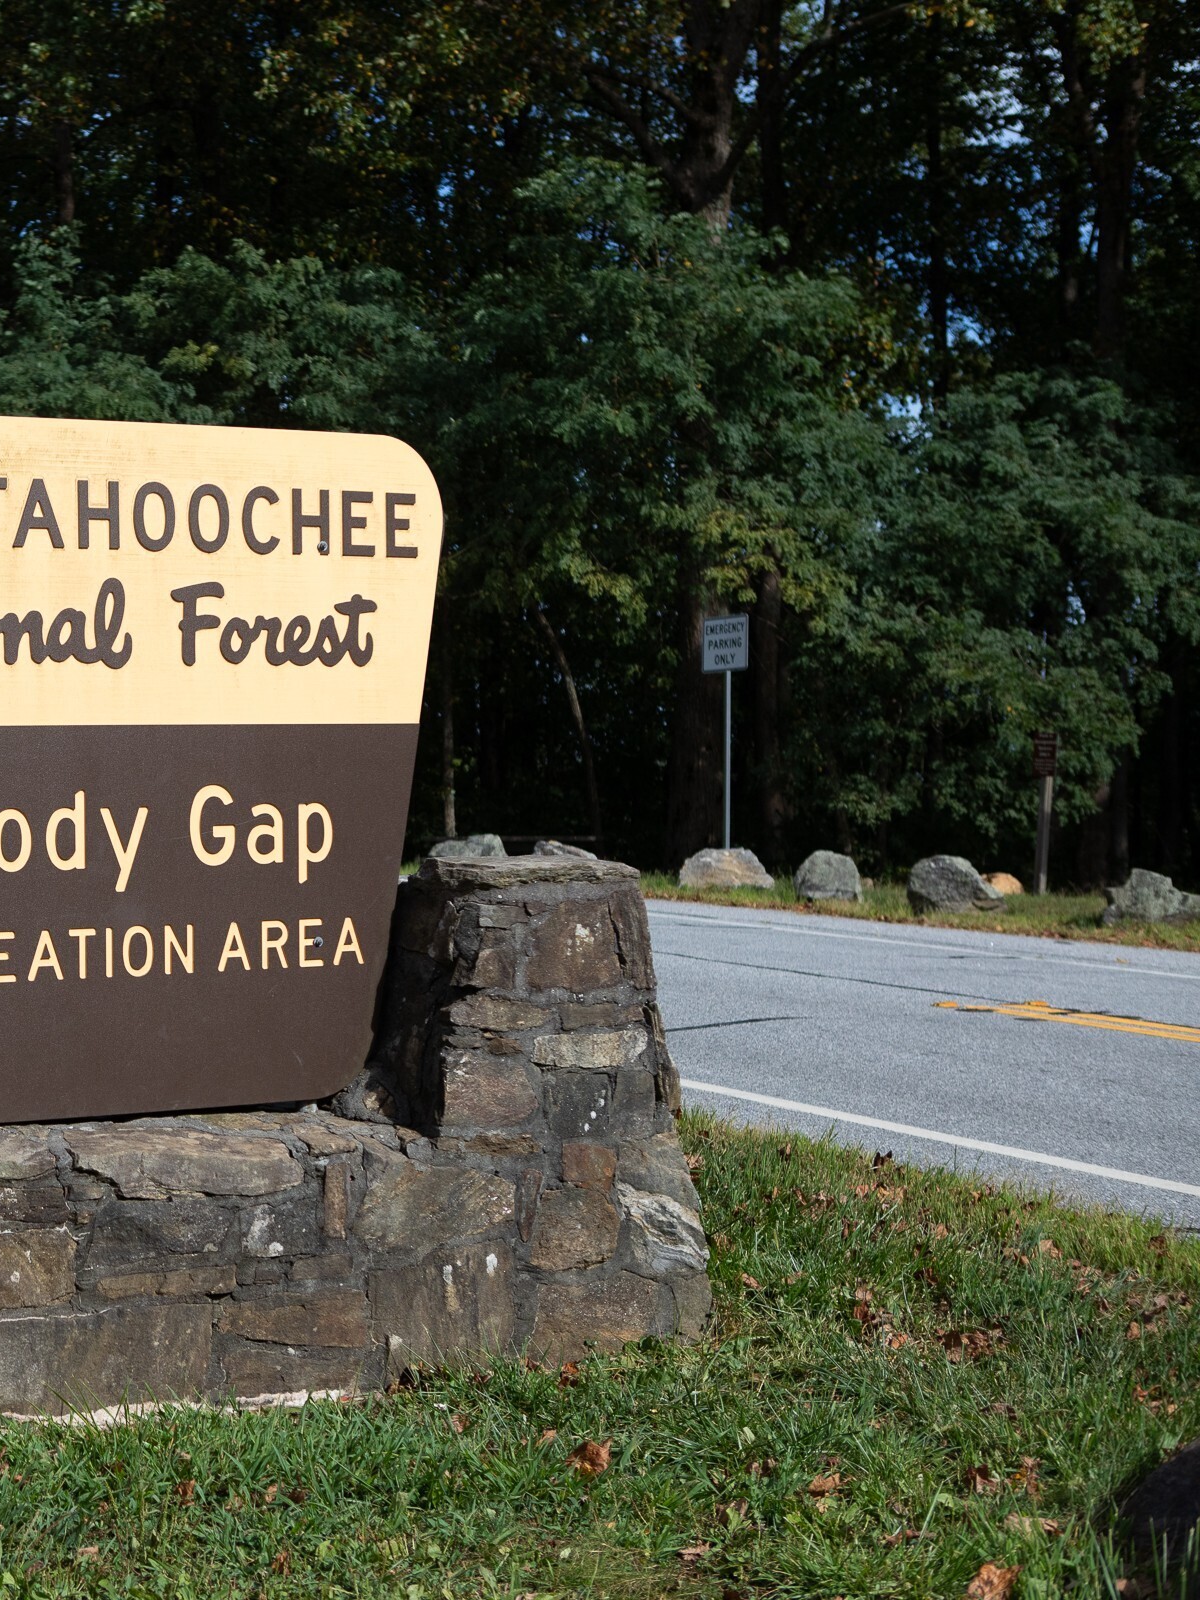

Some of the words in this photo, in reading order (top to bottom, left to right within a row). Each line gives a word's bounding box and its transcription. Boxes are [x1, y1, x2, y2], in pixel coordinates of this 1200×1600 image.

[171, 582, 378, 667] Forest
[705, 622, 745, 636] EMERGENCY
[708, 637, 743, 651] PARKING
[714, 653, 736, 666] ONLY
[189, 784, 334, 884] Gap
[218, 917, 365, 972] AREA
